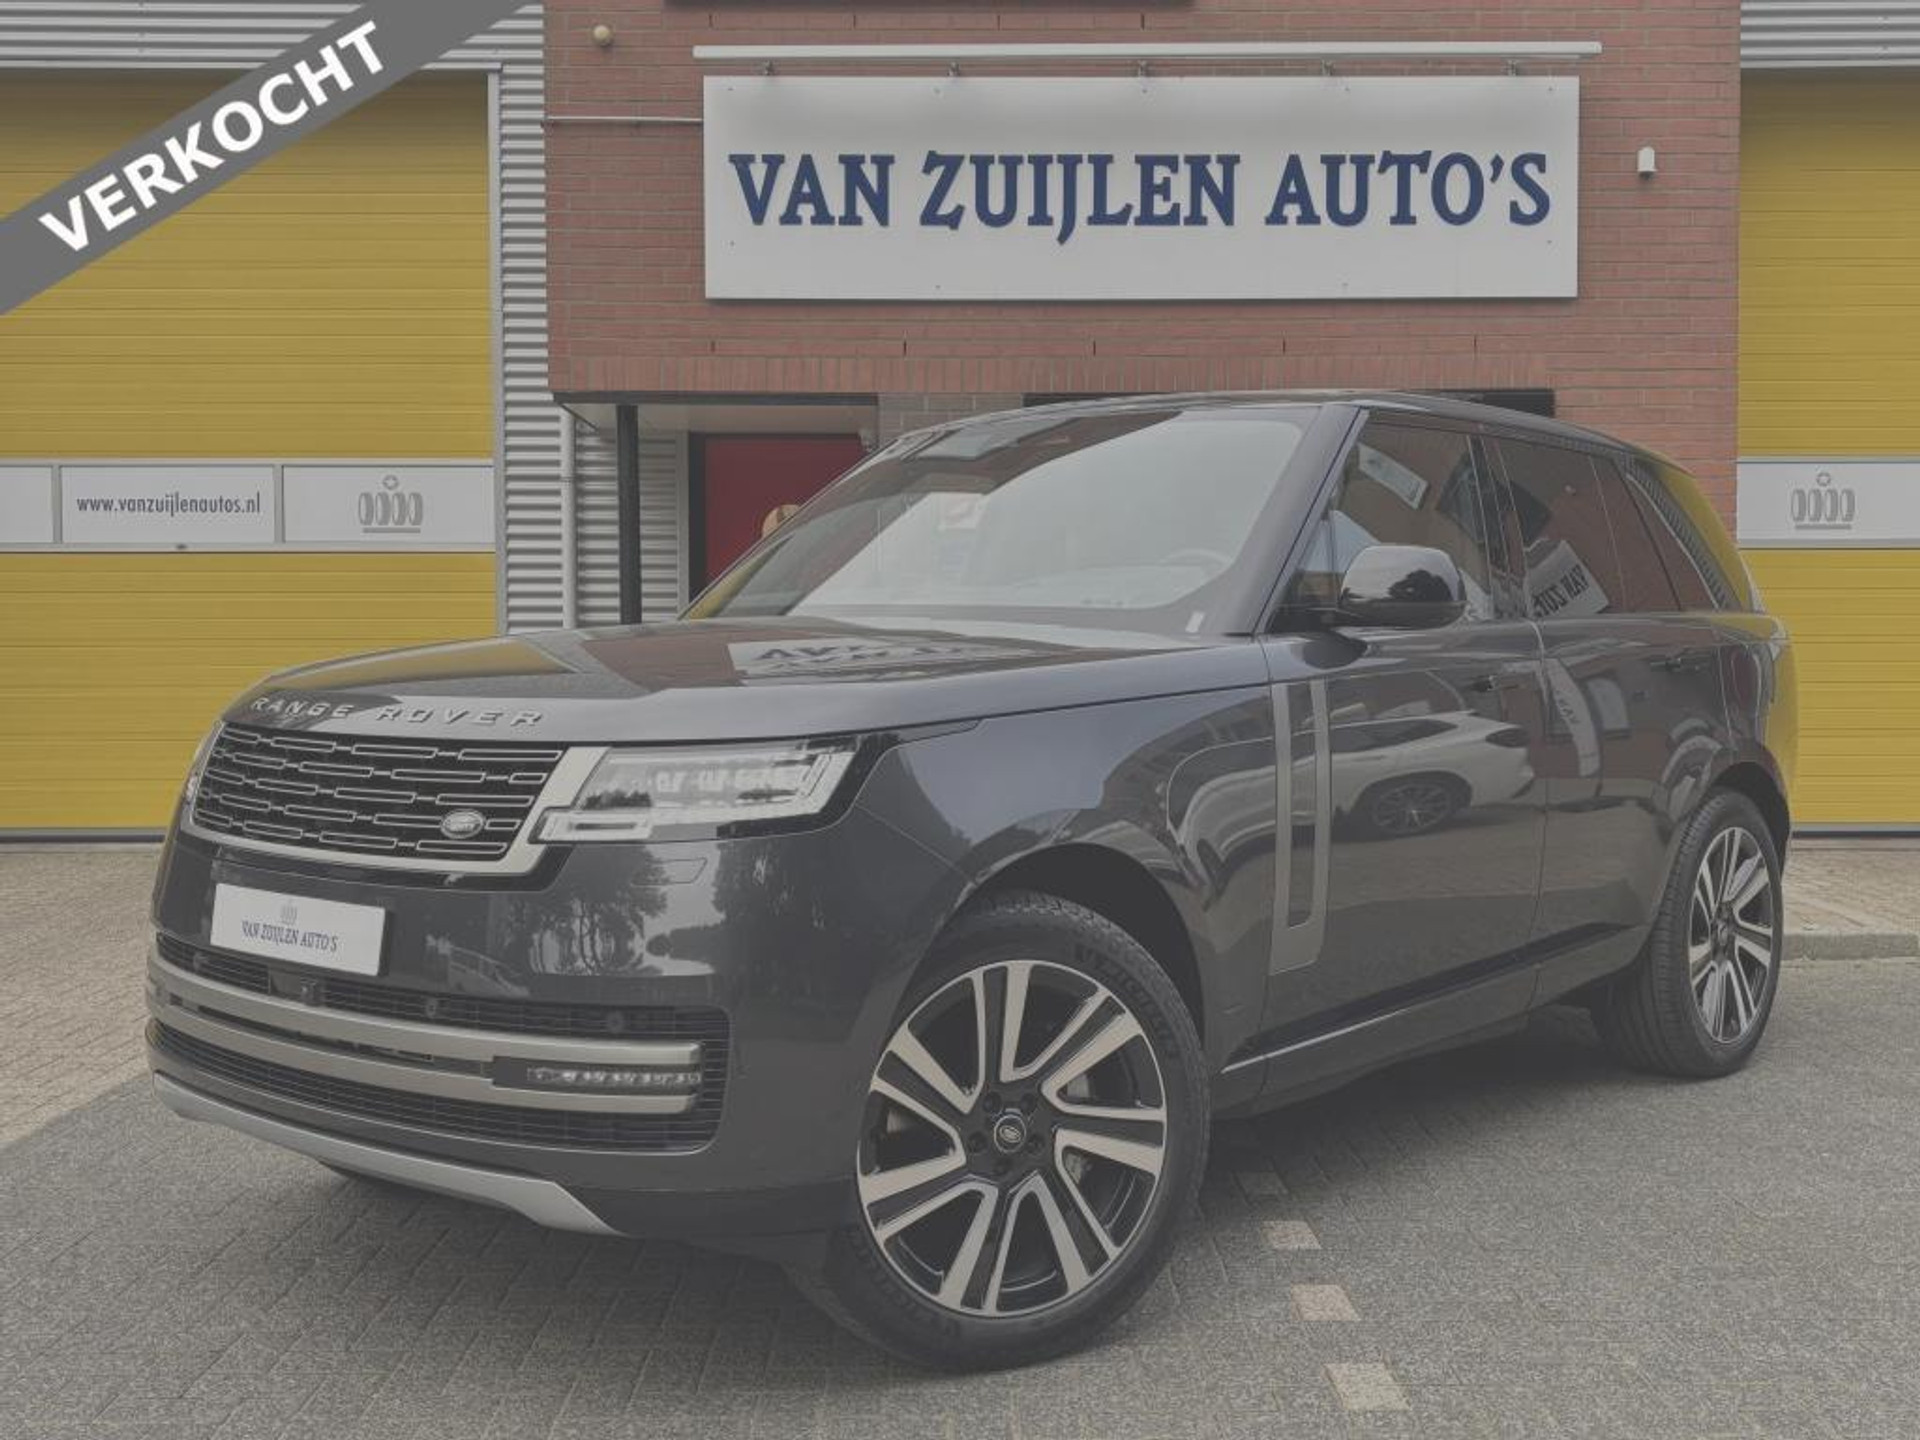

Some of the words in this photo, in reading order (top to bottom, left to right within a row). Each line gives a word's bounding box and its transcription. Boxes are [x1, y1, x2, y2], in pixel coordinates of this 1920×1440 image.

[728, 153, 896, 227] VAN
[919, 149, 1241, 246] ZUIJLEN
[1265, 149, 1551, 227] AUTO'S
[76, 492, 260, 517] www.vanzuijlenautos.nl
[251, 698, 353, 718] RANGE
[377, 705, 542, 727] ROVER
[242, 920, 260, 938] VAN
